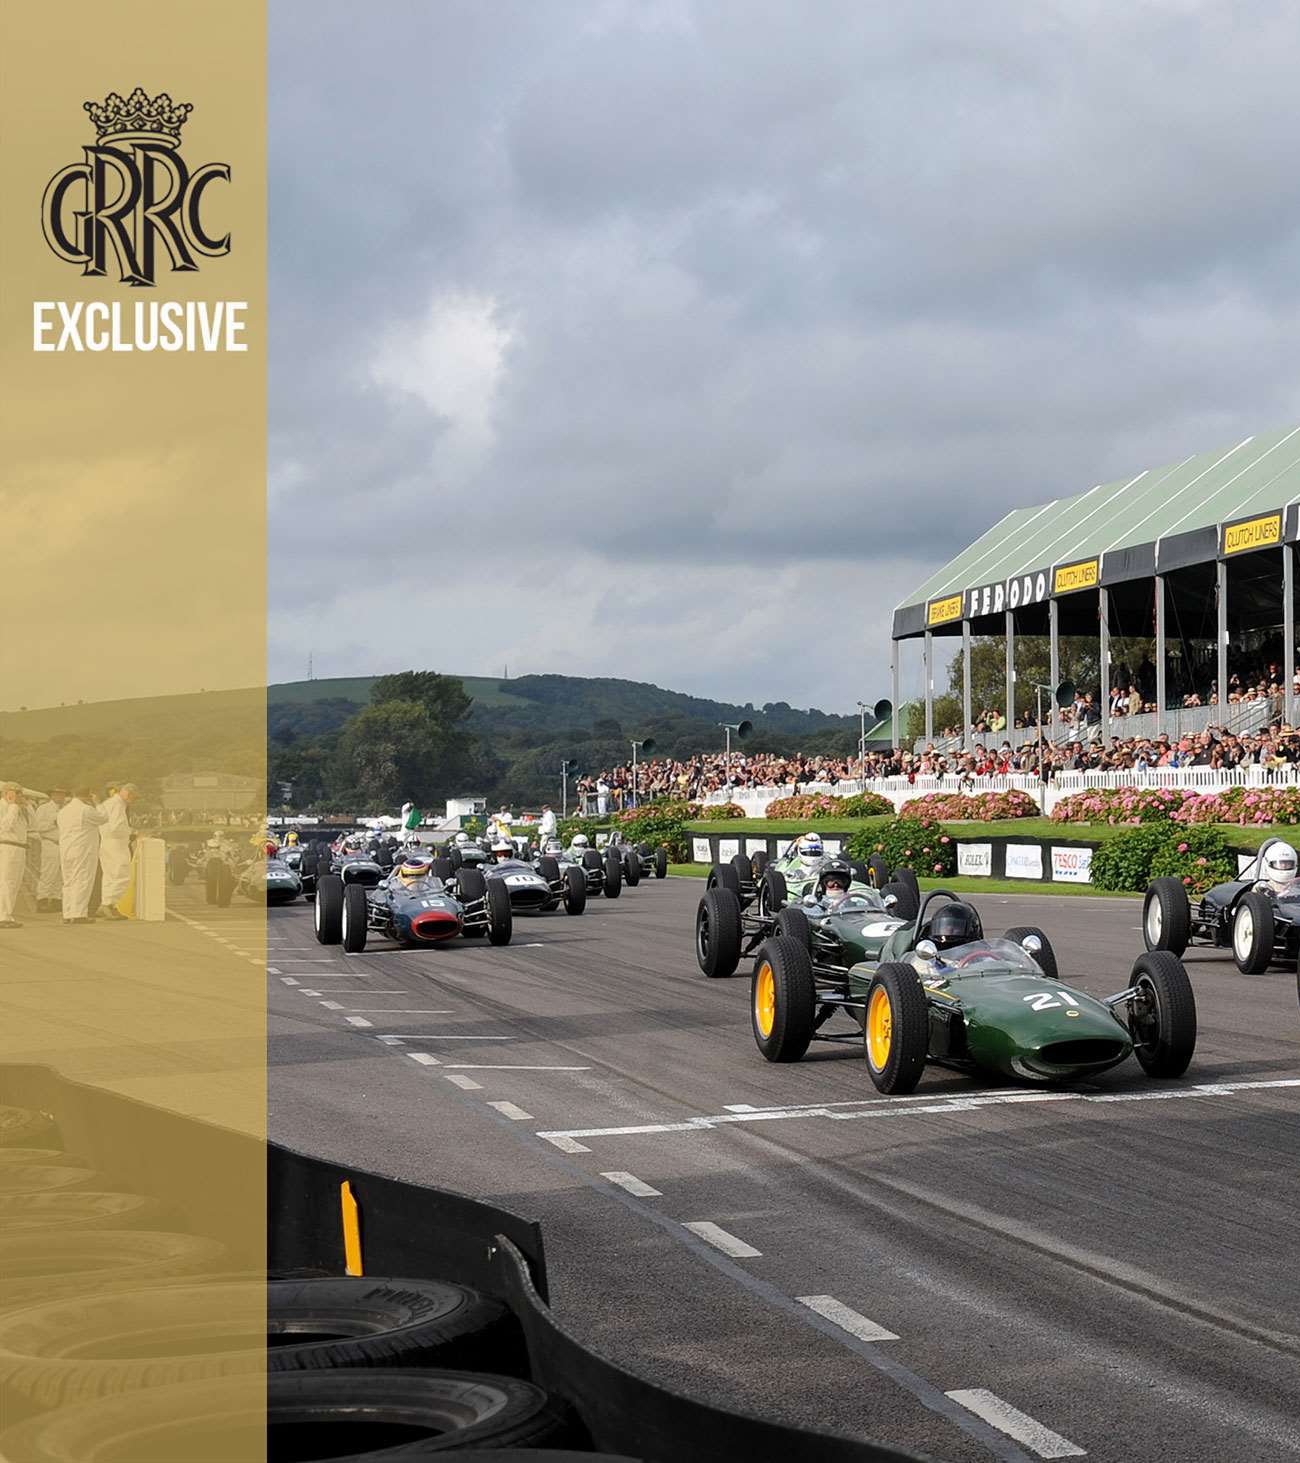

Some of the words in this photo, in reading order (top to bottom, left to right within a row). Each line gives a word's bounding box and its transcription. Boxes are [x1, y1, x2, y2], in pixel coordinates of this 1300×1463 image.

[1227, 526, 1254, 548] CLUTCH
[1255, 520, 1278, 541] LINERS
[970, 573, 1045, 617] FERODO
[1054, 853, 1078, 869] TESCO
[1023, 991, 1080, 1012] 21
